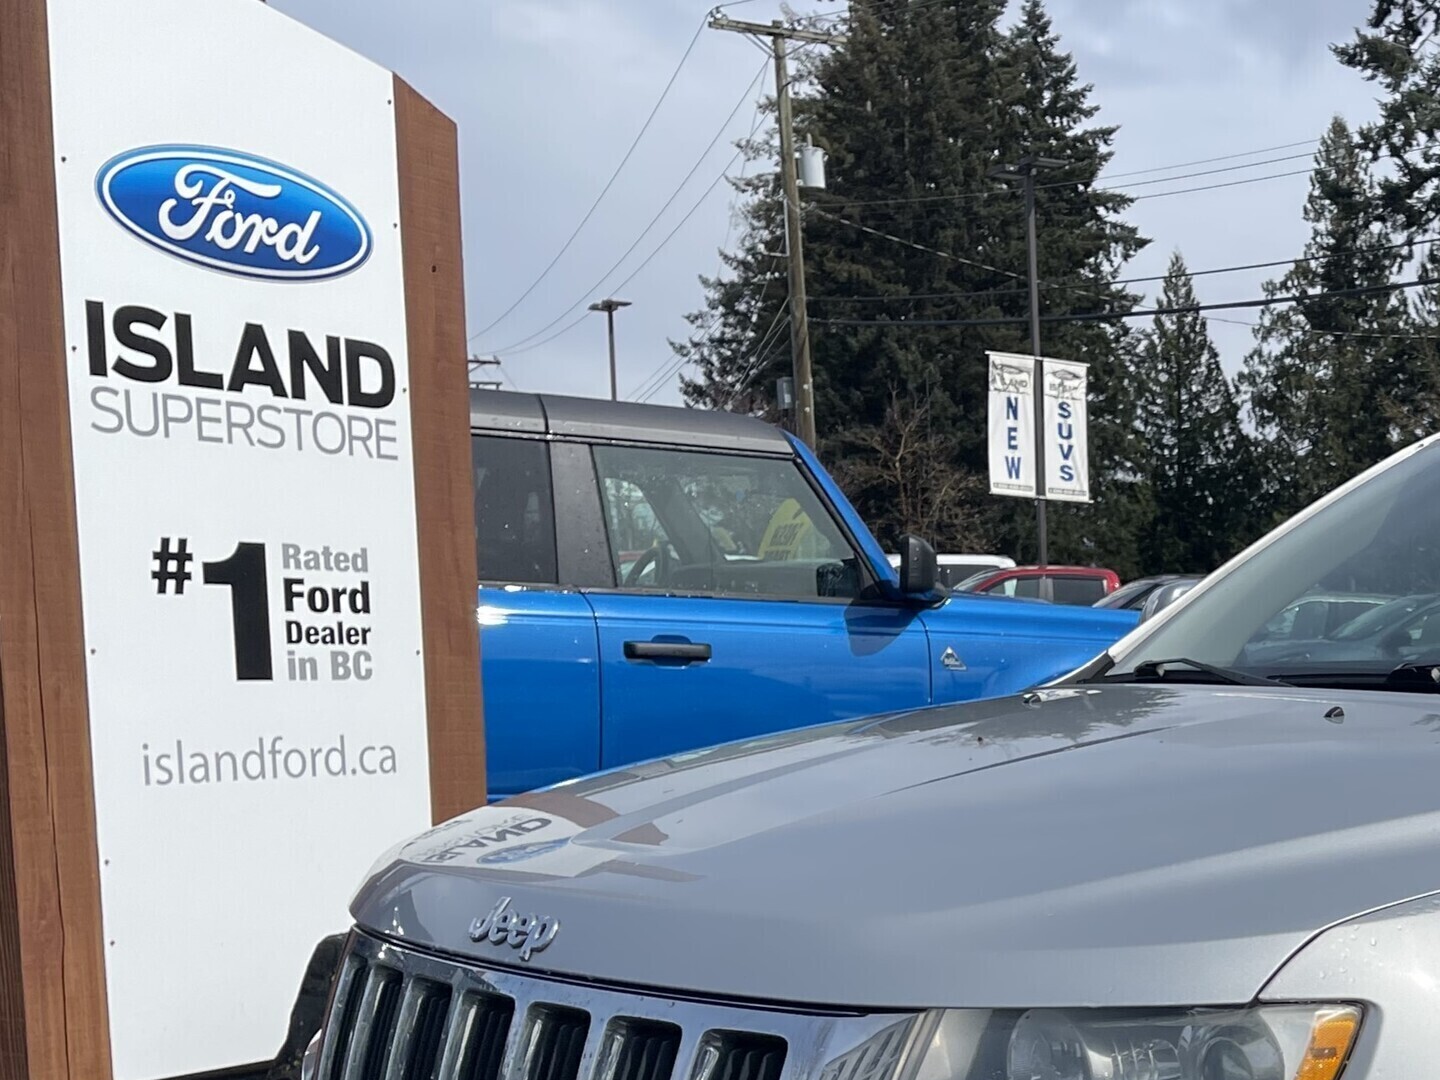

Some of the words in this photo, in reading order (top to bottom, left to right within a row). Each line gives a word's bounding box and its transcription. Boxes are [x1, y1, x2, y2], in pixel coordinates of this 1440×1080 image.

[158, 163, 322, 264] Ford
[85, 299, 396, 409] ISLAND
[90, 386, 399, 461] SUPERSTORE
[1005, 396, 1021, 480] NEW
[1057, 401, 1074, 482] SUVS
[281, 543, 369, 573] Rated
[283, 577, 371, 614] Ford
[285, 619, 371, 645] Dealer
[287, 650, 318, 681] in
[330, 650, 373, 681] BC
[142, 734, 397, 786] islandford.ca
[468, 896, 561, 961] Jeep
